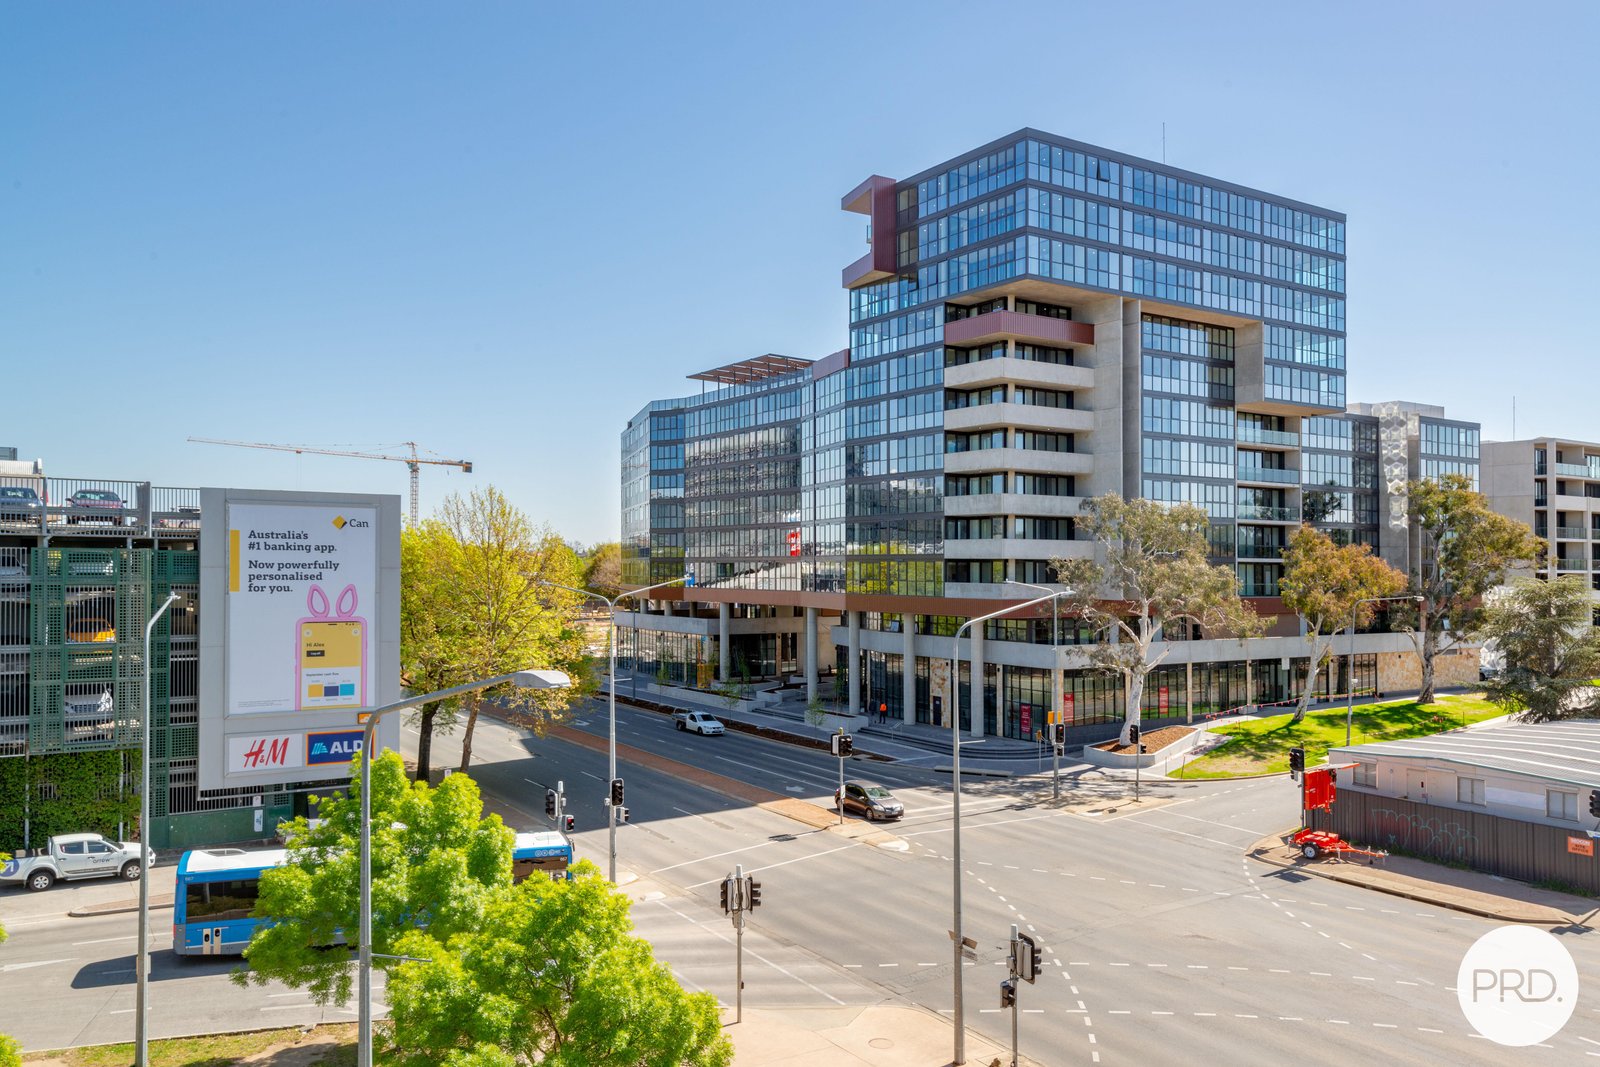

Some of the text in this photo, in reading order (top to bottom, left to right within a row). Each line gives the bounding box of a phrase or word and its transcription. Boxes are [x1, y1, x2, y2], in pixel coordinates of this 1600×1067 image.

[349, 518, 369, 528] Can
[248, 529, 309, 540] Australia's
[248, 541, 337, 554] #1 banking app.
[248, 559, 340, 571] Now powerfully
[248, 571, 323, 582] personalised
[248, 583, 293, 594] for you.
[330, 740, 363, 754] ALD
[243, 737, 290, 769] H&M
